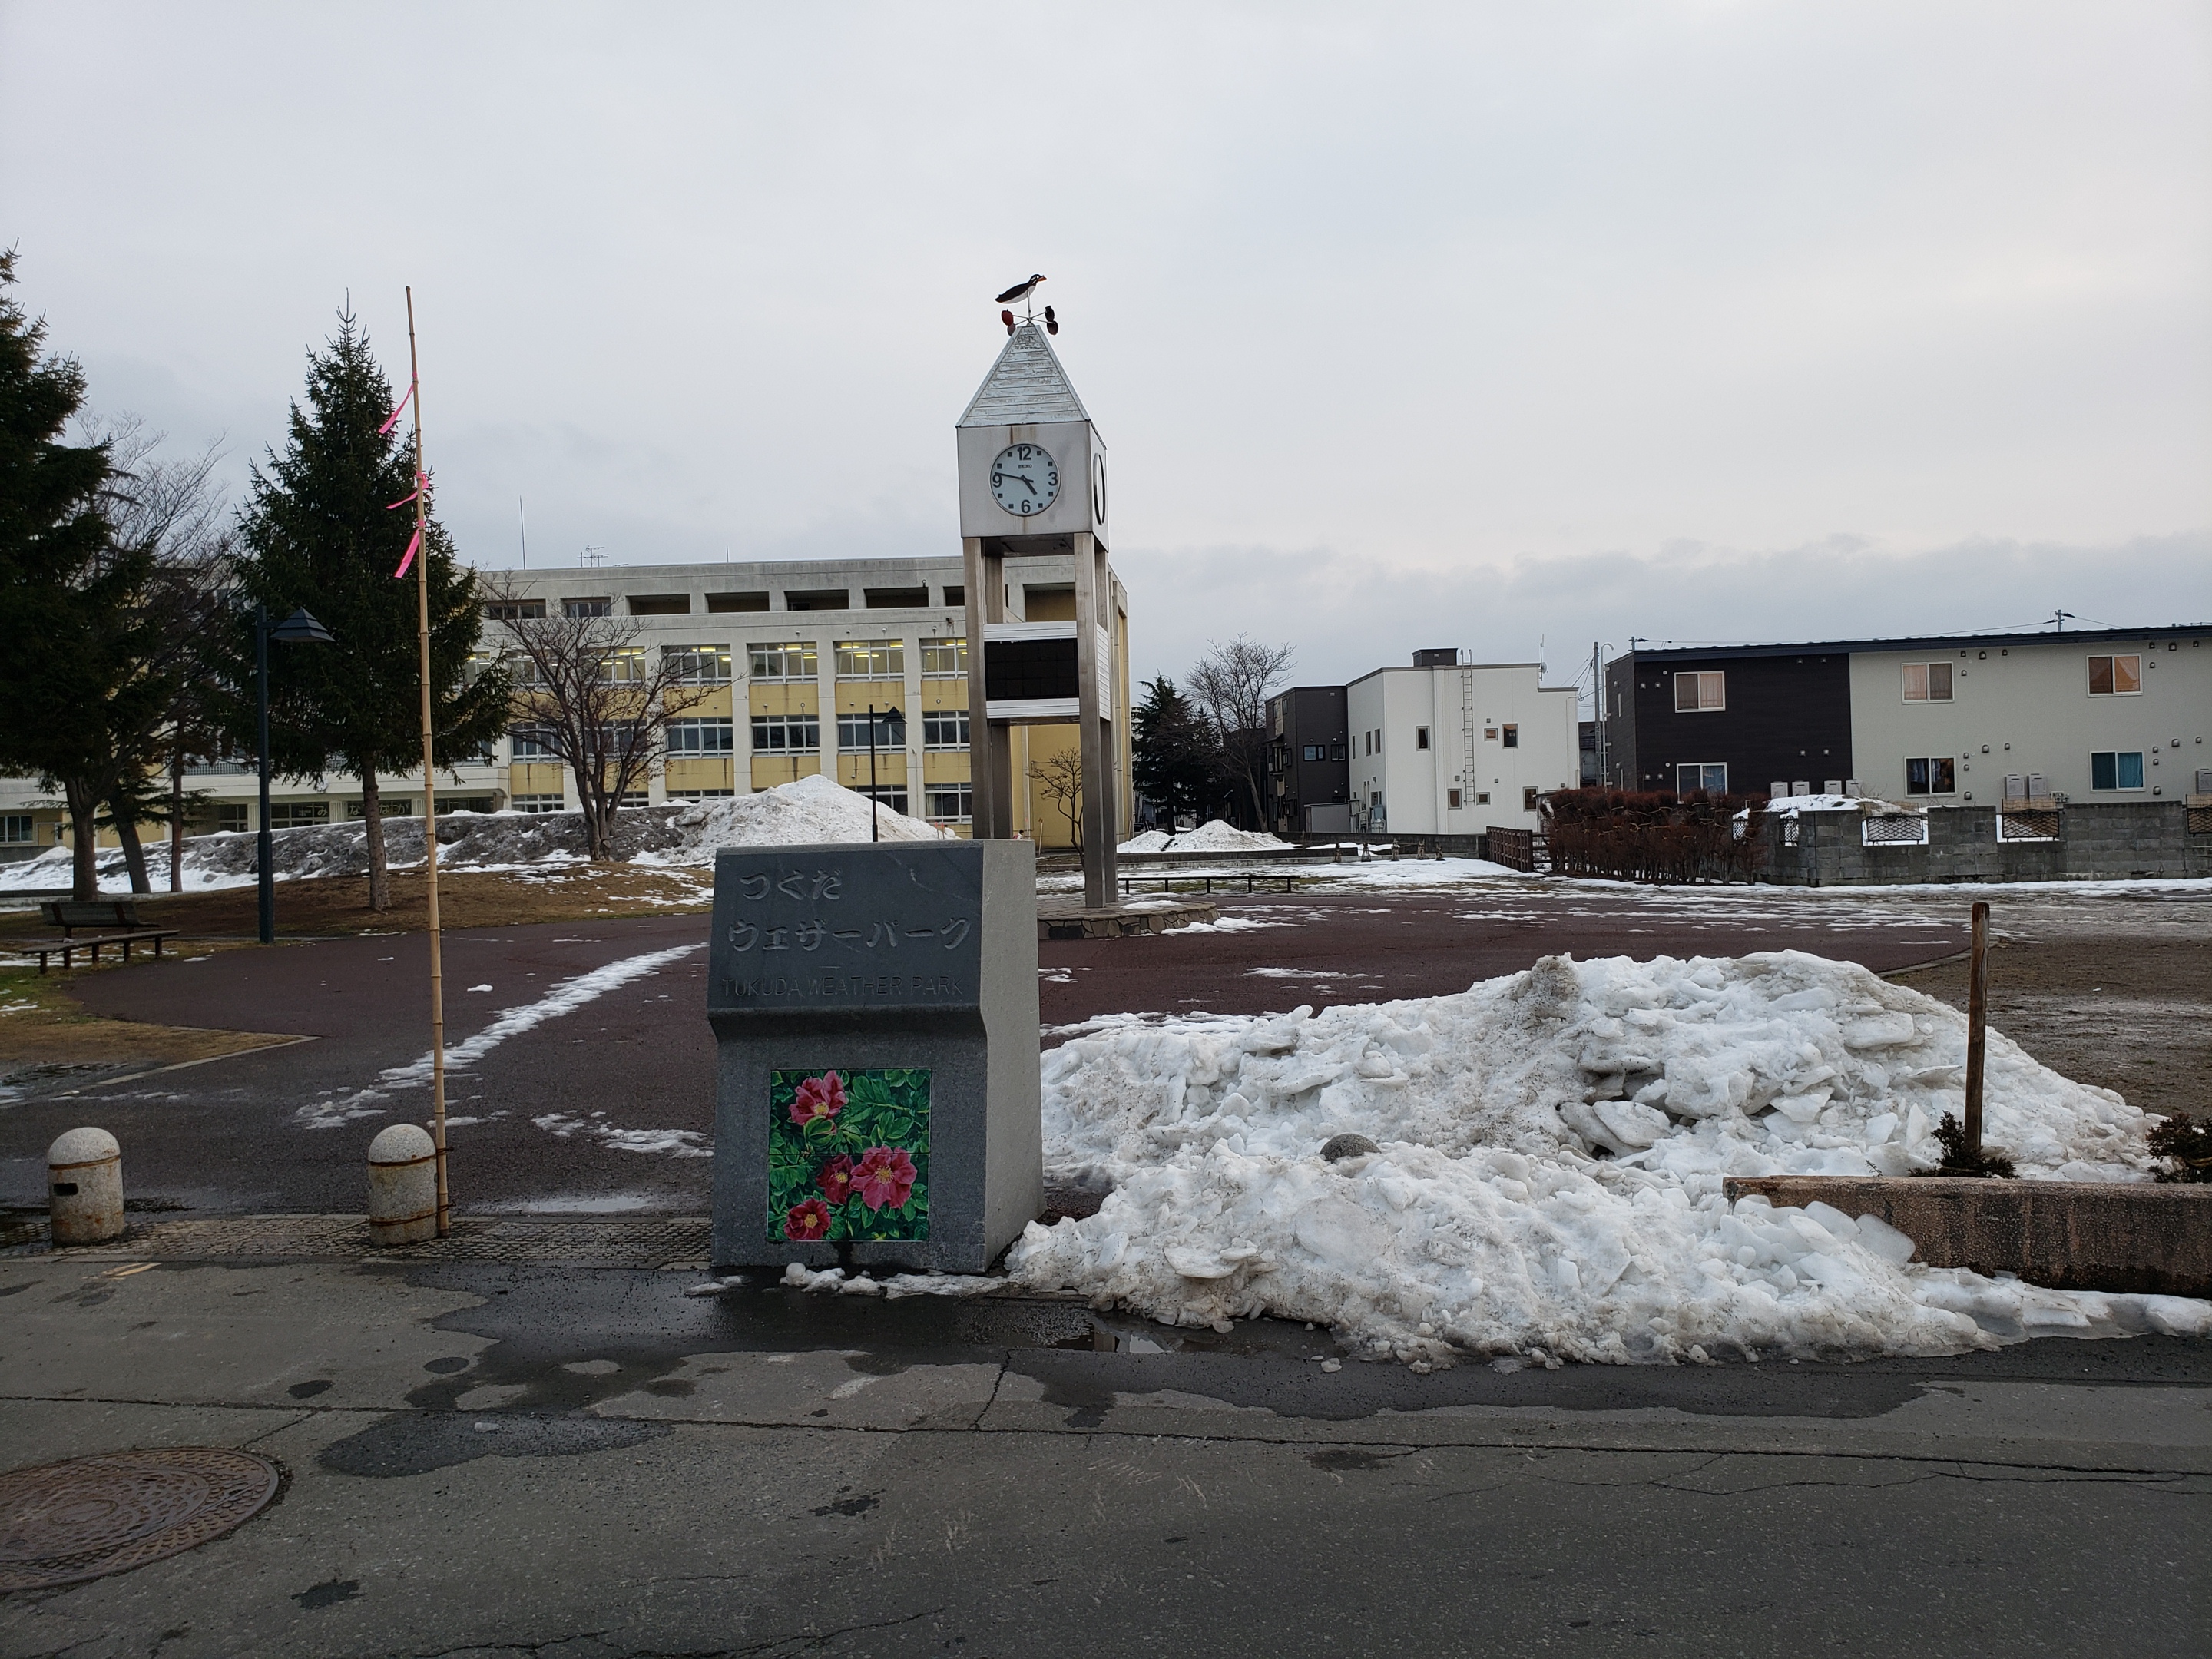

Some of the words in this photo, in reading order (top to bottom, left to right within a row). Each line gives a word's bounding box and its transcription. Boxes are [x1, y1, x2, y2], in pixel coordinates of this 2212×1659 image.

[1017, 446, 1031, 461] 12
[992, 474, 1002, 488] 9
[1048, 472, 1058, 486] 3
[1021, 499, 1031, 513] 6
[740, 868, 842, 900] つくだ
[722, 976, 804, 997] TUKUDA
[806, 976, 902, 996] WEATHER
[910, 975, 964, 995] PARK
